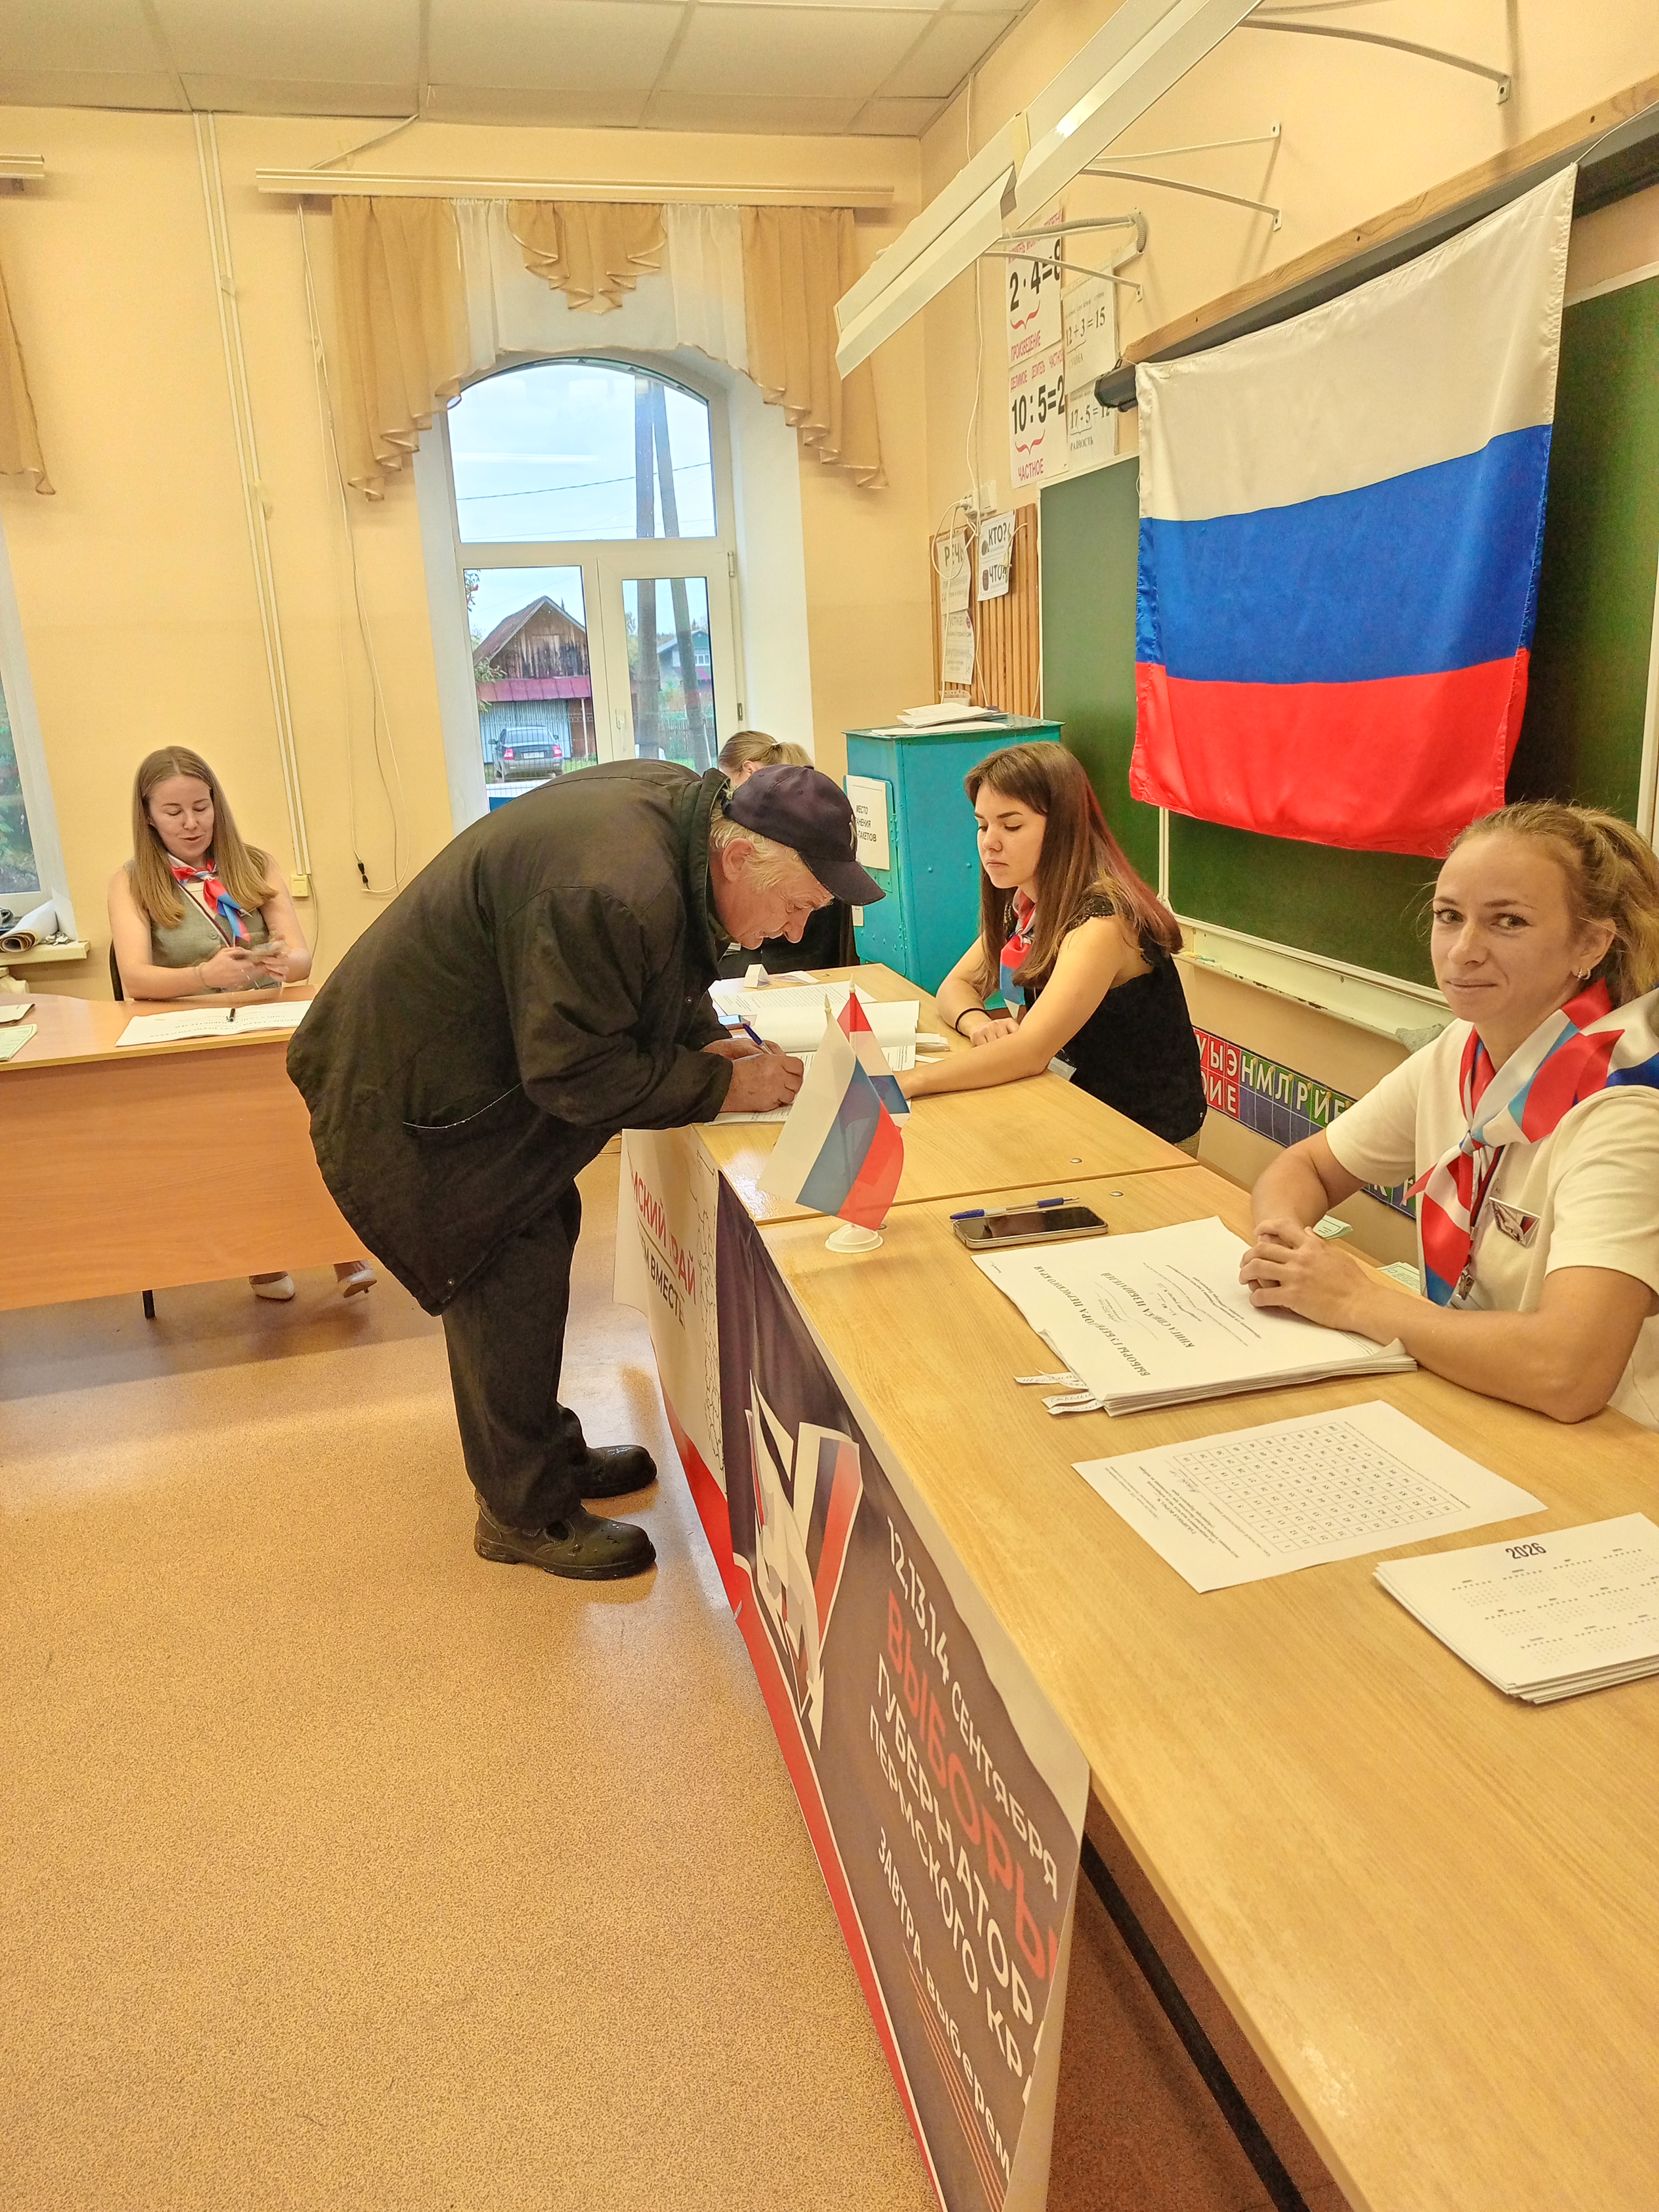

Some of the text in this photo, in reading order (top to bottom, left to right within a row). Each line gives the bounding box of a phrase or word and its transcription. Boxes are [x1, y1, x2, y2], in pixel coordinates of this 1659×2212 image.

[1018, 457, 1045, 481] ЧАСТНОЕ
[856, 805, 868, 815] МЕСТО
[1505, 1542, 1547, 1559] 2026
[869, 1704, 979, 1995] ПЕРМСКОГО
[888, 1588, 1058, 1986] ВЫБОРЫ
[952, 1681, 1058, 1901] СЕНТЯБРЯ
[877, 1826, 924, 1976] ЗАВТРА
